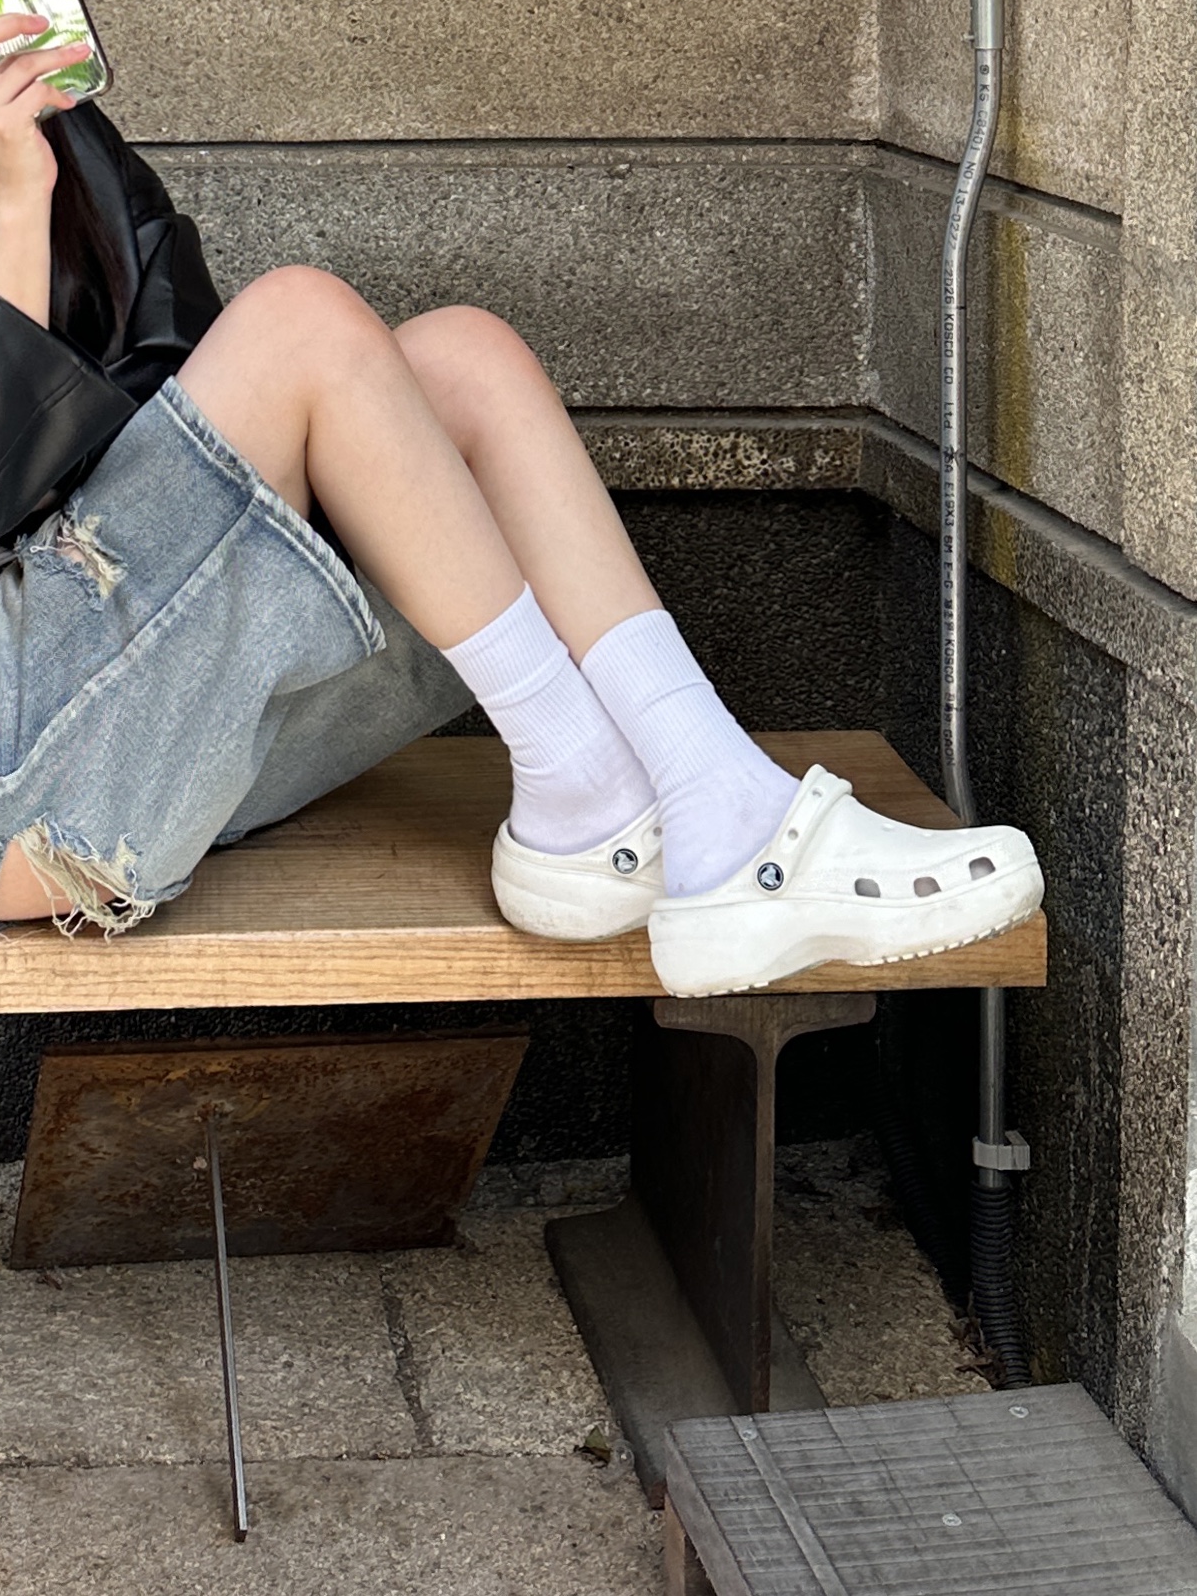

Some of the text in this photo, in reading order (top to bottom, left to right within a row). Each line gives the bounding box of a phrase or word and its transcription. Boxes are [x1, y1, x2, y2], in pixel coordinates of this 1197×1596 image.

[979, 84, 991, 102] KS
[943, 313, 955, 358] KOSCO
[943, 638, 955, 684] KOSCO
[943, 729, 956, 766] GAON
